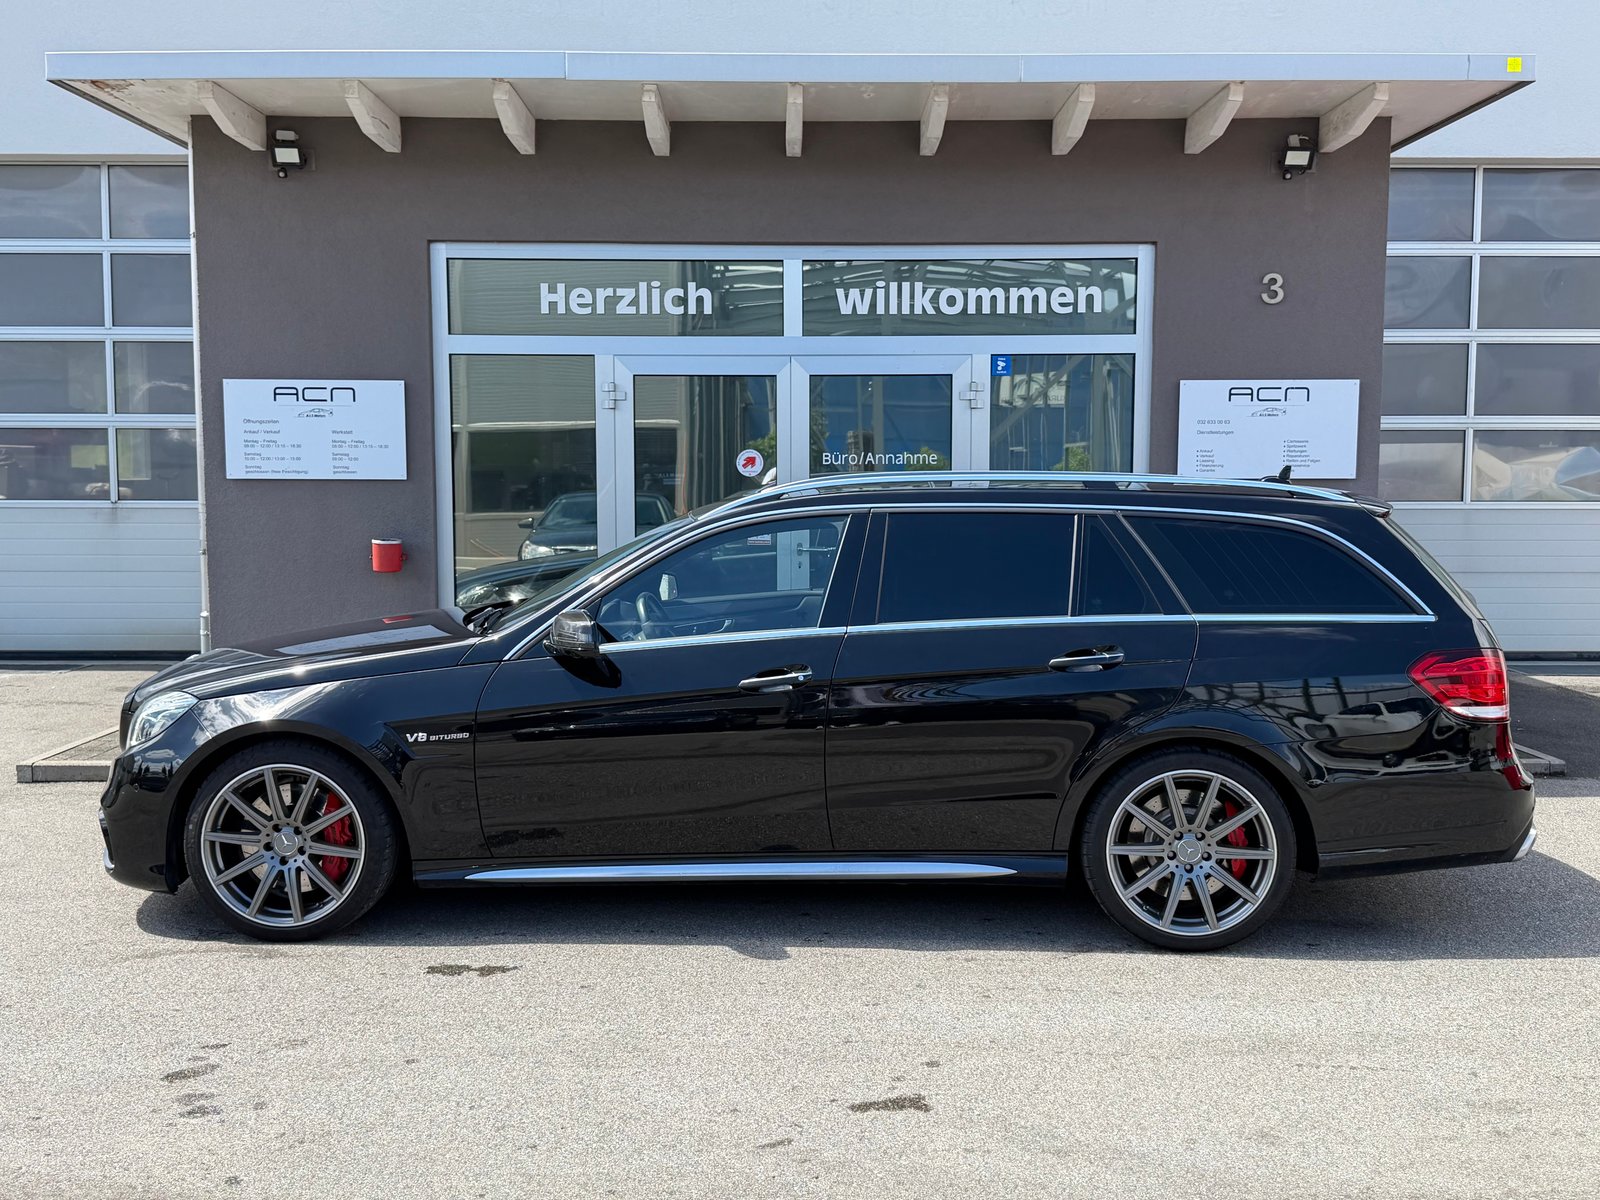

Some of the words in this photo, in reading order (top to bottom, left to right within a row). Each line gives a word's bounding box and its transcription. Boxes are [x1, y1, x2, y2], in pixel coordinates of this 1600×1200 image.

[1261, 272, 1284, 304] 3
[540, 281, 713, 315] Herzlich
[835, 281, 1102, 315] willkommen
[273, 386, 356, 402] ACN
[1228, 387, 1310, 402] ACN
[822, 451, 938, 465] Büro/Annahme
[406, 732, 428, 743] V8
[429, 732, 470, 741] BITURBO
